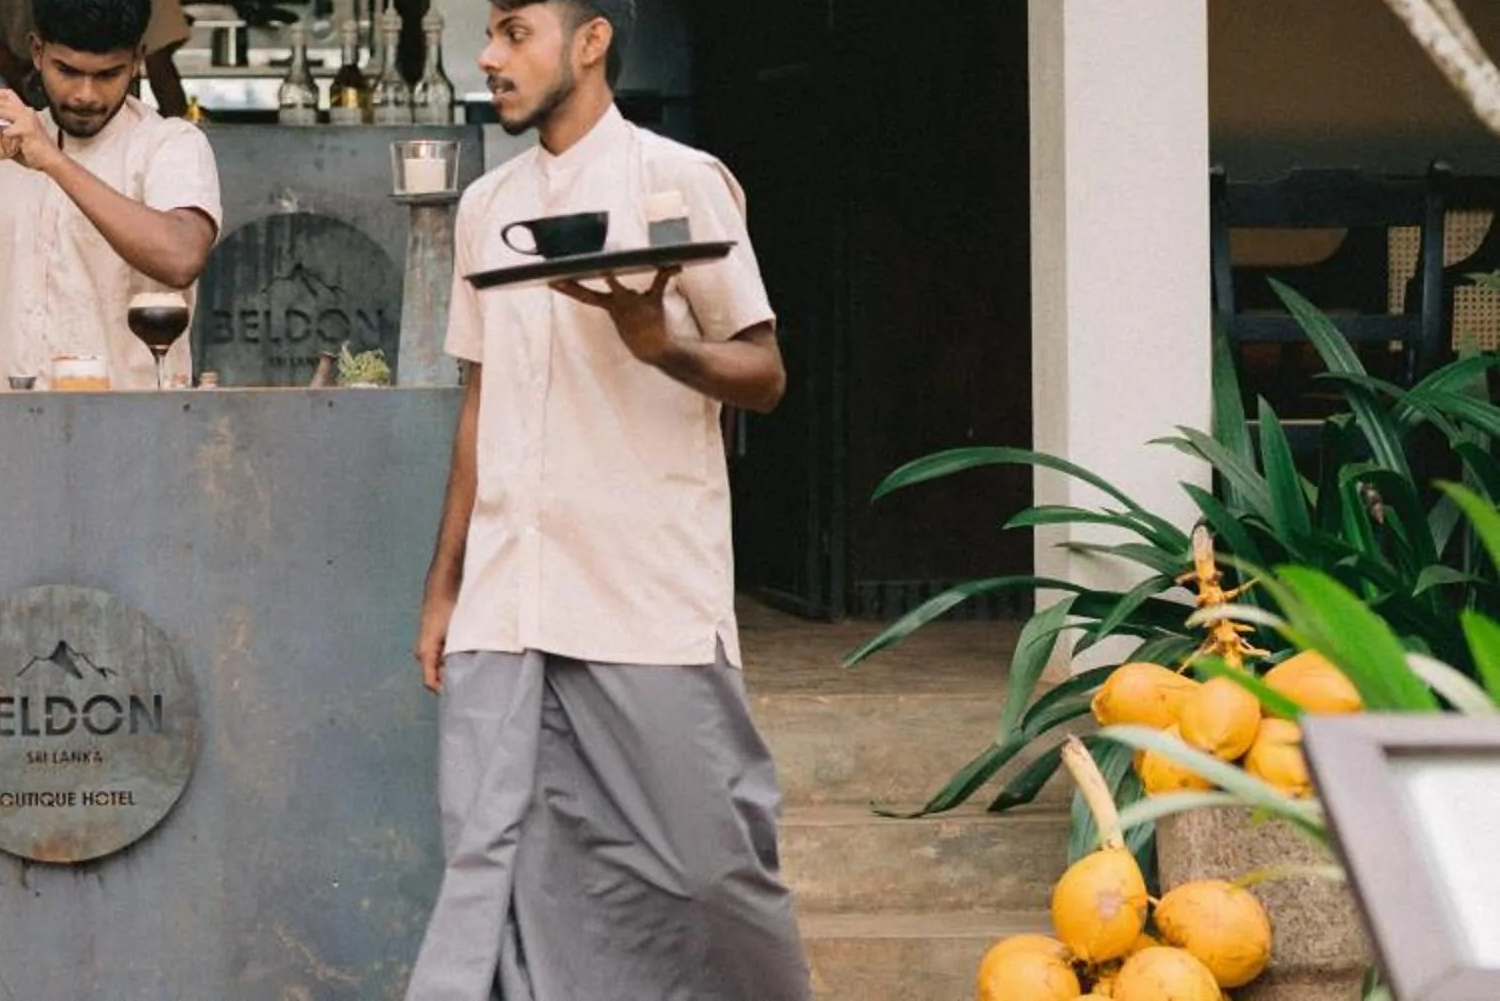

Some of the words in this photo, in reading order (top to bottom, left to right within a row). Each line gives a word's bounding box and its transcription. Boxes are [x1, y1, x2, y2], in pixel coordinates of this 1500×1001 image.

[211, 308, 386, 345] BELDON
[26, 751, 47, 764] SRI
[52, 750, 103, 764] LANKA
[82, 791, 136, 806] HOTEL
